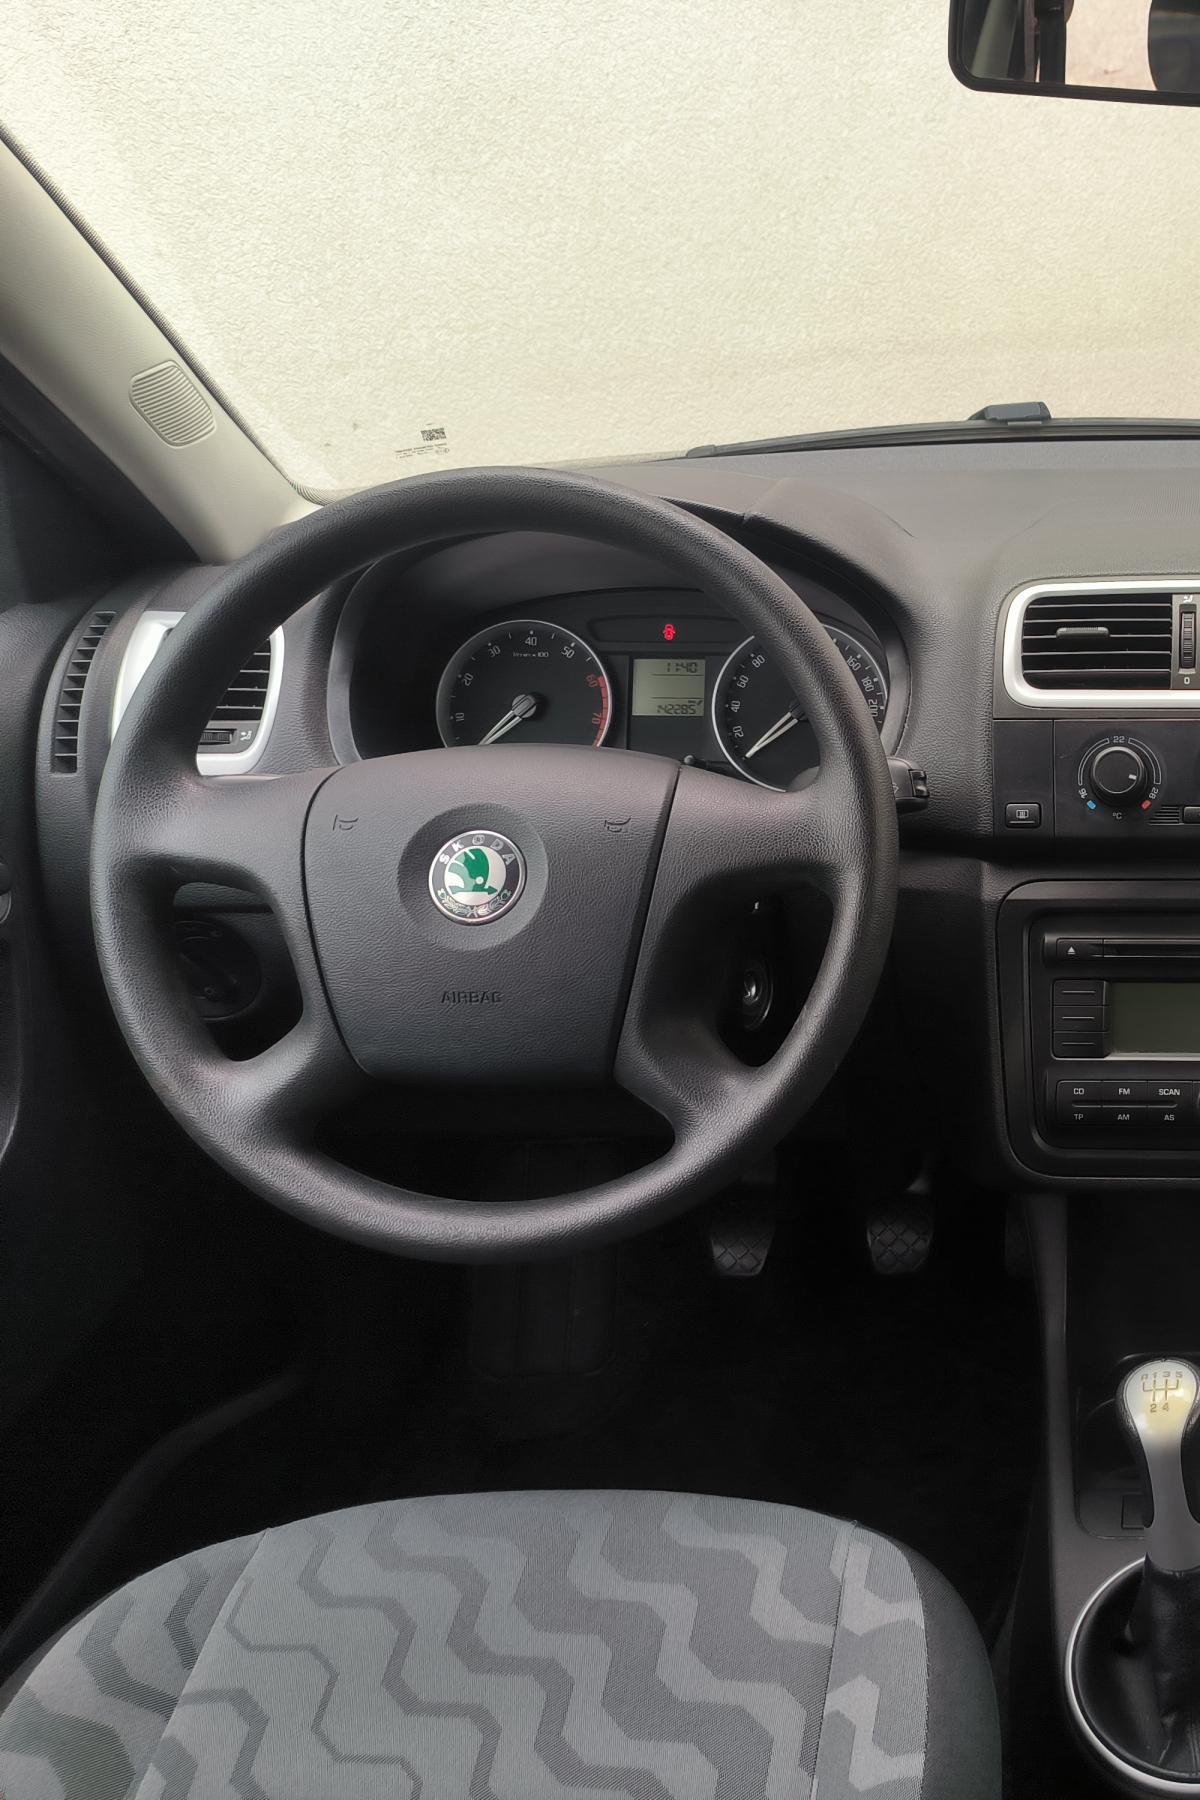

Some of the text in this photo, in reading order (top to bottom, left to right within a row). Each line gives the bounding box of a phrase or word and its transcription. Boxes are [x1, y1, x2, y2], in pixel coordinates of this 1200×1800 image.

[524, 636, 537, 646] 40
[489, 645, 501, 658] 30
[561, 646, 575, 659] 50
[751, 655, 766, 668] 80
[847, 655, 862, 671] 160
[462, 673, 474, 687] 20
[586, 674, 598, 688] 60
[736, 675, 749, 689] 60
[861, 676, 875, 692] 180
[731, 700, 741, 713] 40
[868, 699, 879, 717] 200
[455, 712, 465, 722] 10
[592, 712, 601, 725] 70
[733, 725, 744, 738] 20
[1112, 735, 1126, 743] 22
[1078, 787, 1089, 799] 16
[1148, 786, 1159, 799] 28
[441, 990, 501, 1003] AIRBAG
[1158, 1088, 1181, 1096] SCAN
[1150, 1403, 1157, 1412] 2
[1162, 1402, 1169, 1412] 4
